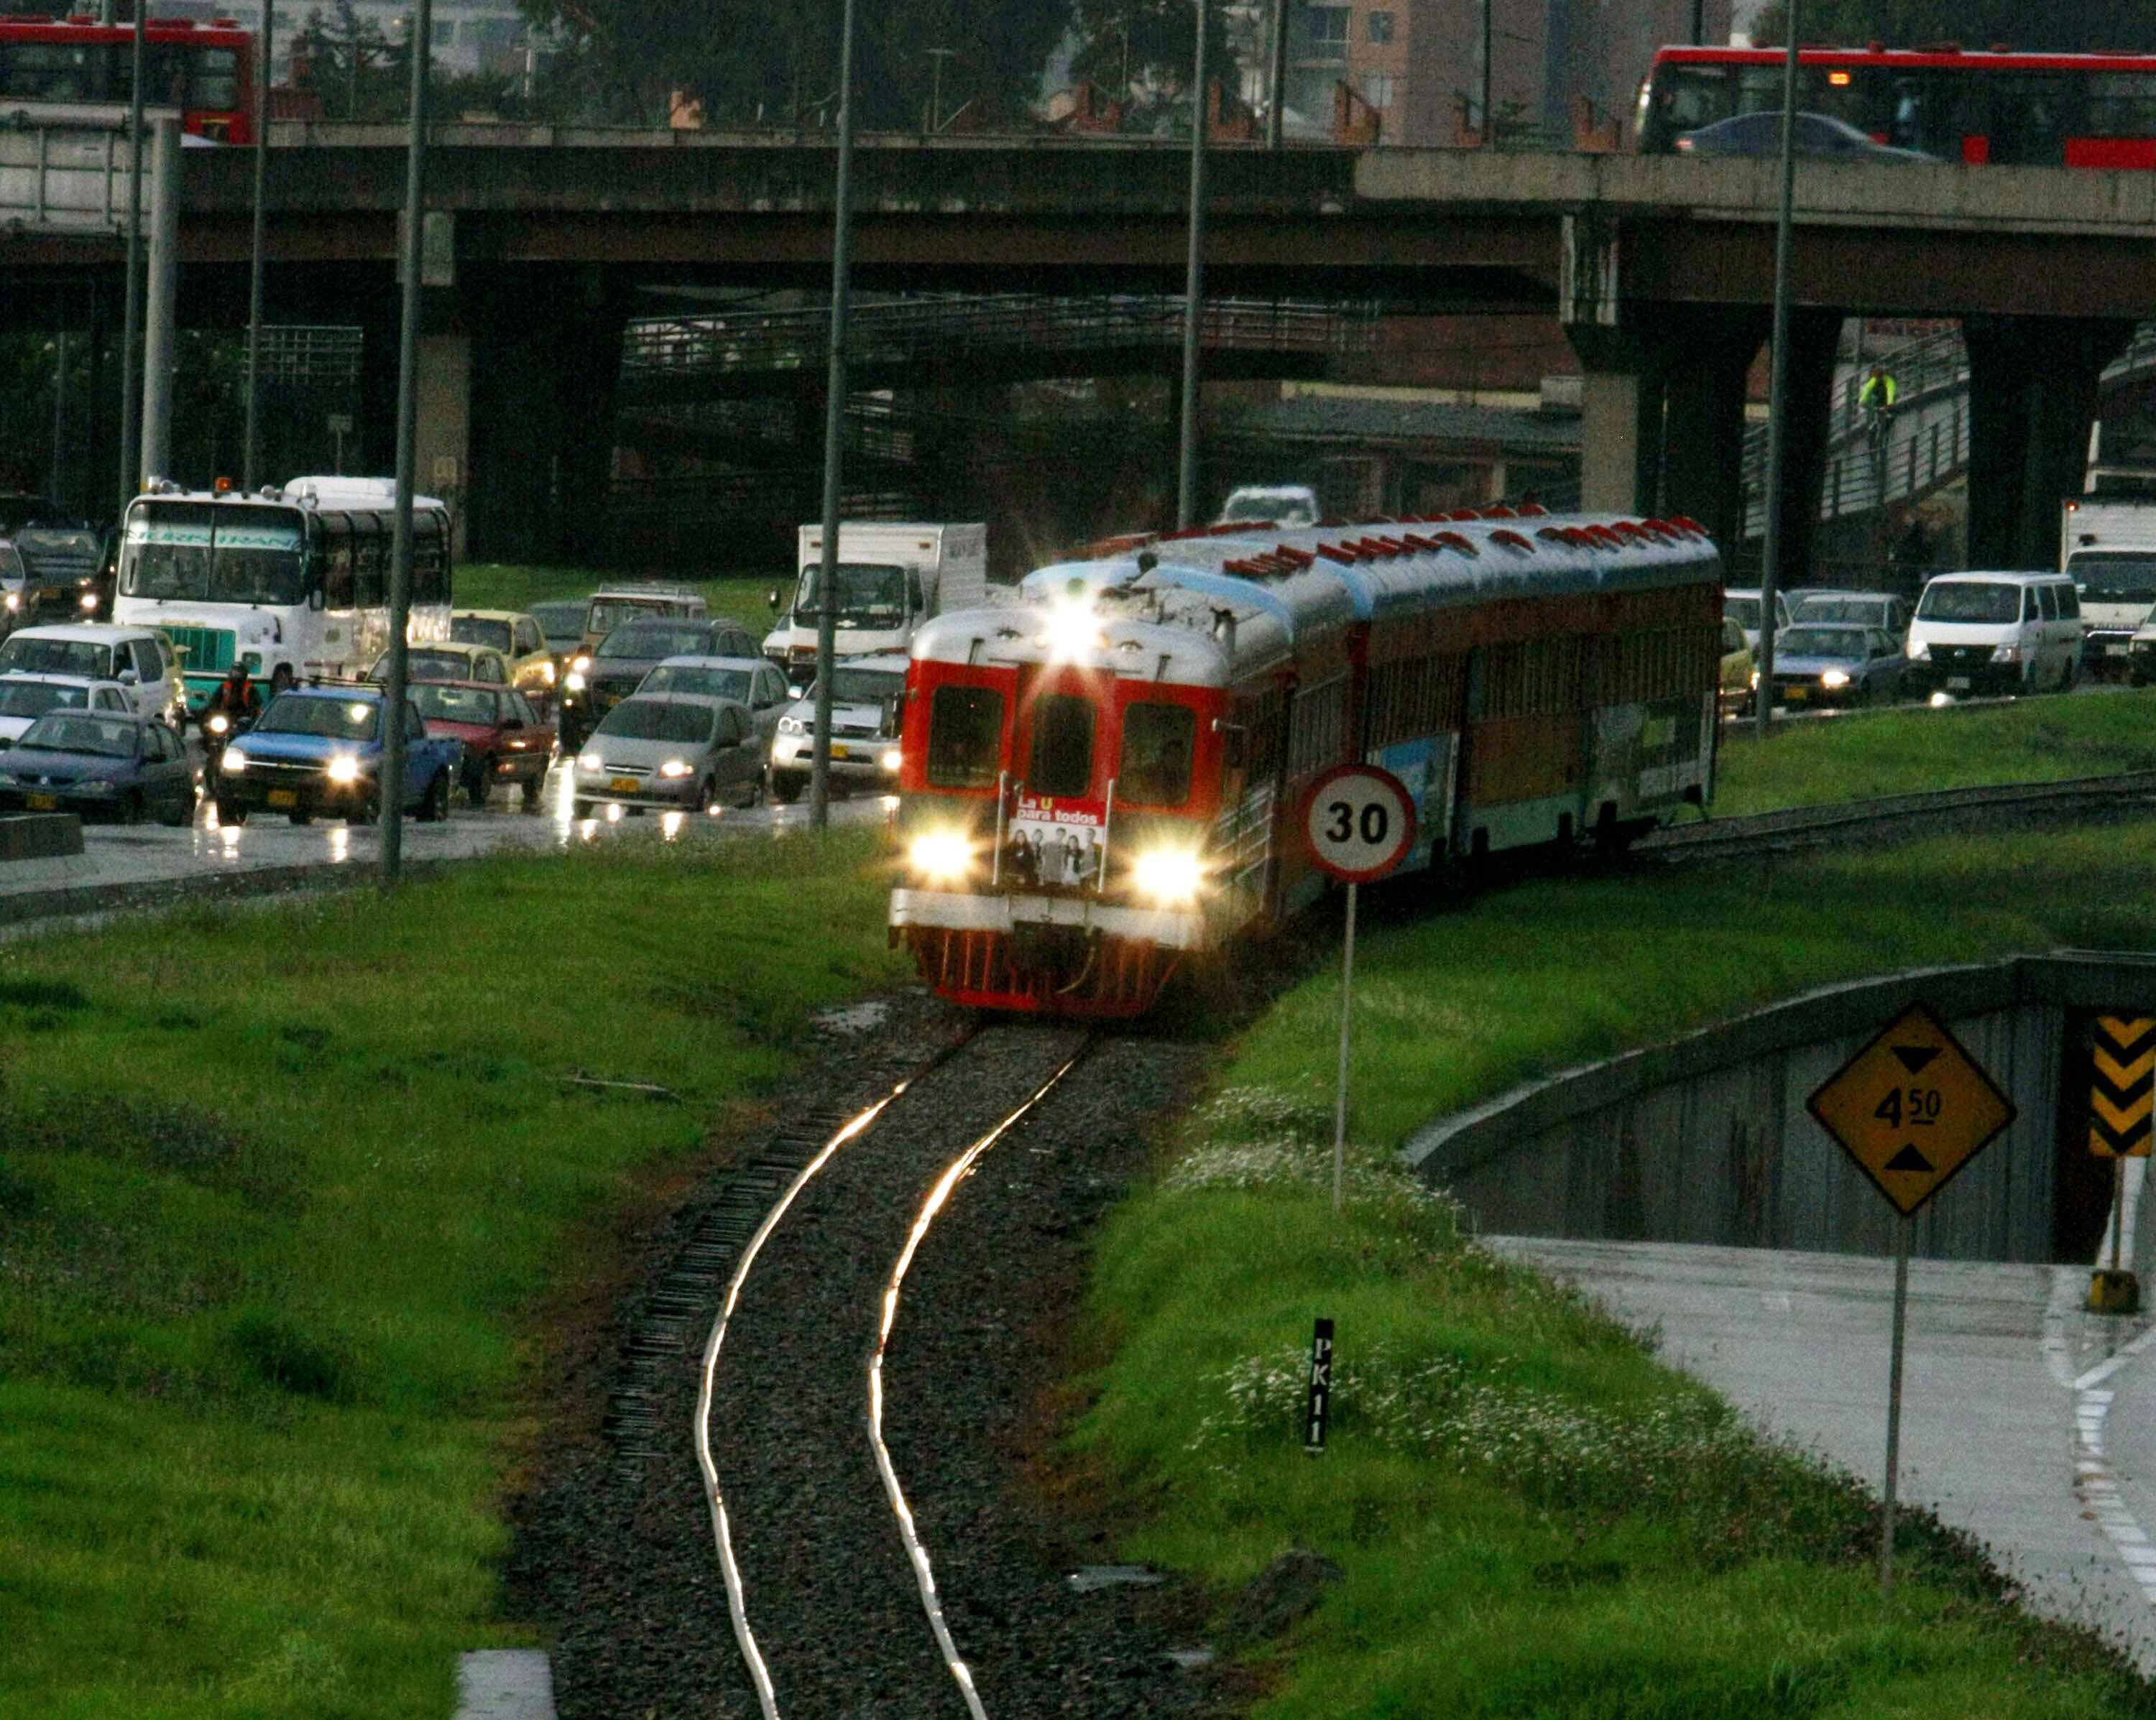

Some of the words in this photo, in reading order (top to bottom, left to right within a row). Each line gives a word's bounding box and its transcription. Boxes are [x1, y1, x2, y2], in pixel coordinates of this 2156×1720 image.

[1018, 793, 1036, 808] La
[1041, 797, 1053, 810] U
[1017, 809, 1051, 821] para
[1055, 810, 1097, 825] todos
[1326, 801, 1388, 844] 30
